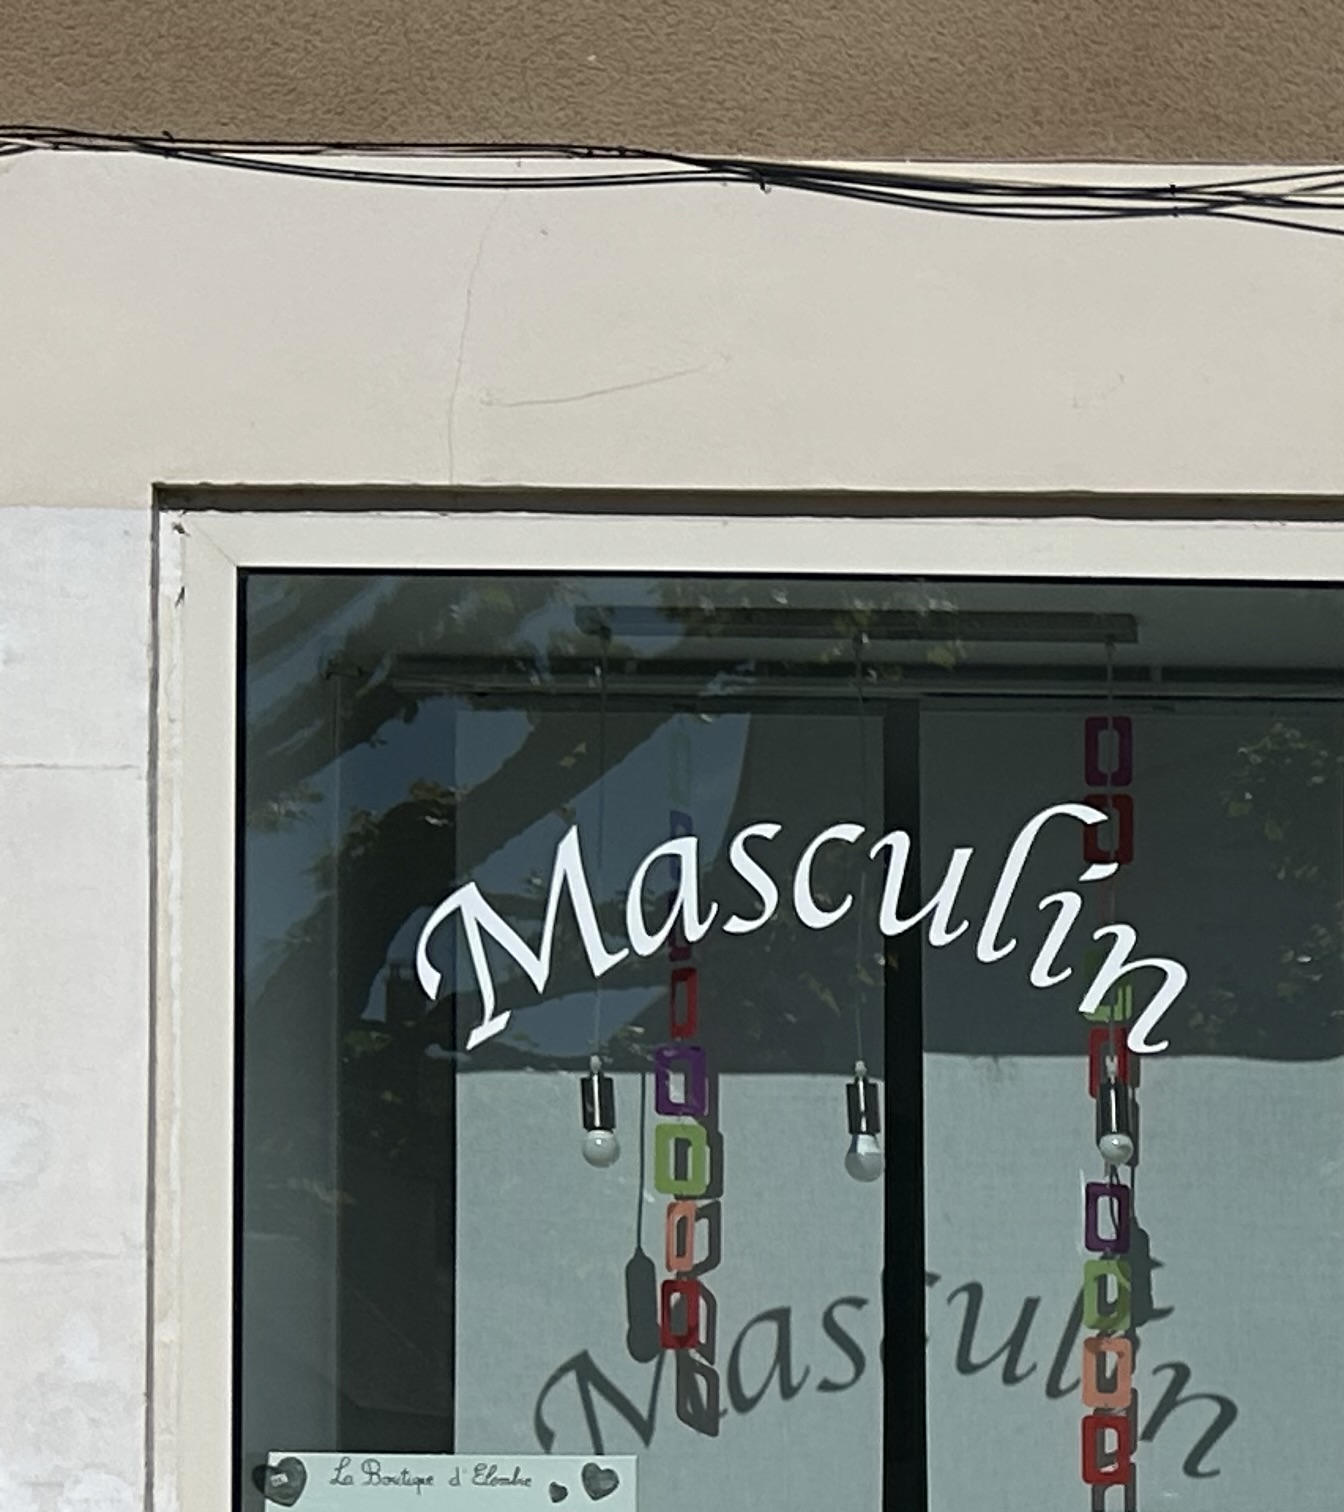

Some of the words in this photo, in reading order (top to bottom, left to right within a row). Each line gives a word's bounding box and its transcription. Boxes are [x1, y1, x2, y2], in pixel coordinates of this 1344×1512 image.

[416, 803, 1188, 1053] Masculin
[329, 1456, 354, 1486] La
[360, 1458, 435, 1496] Boutique
